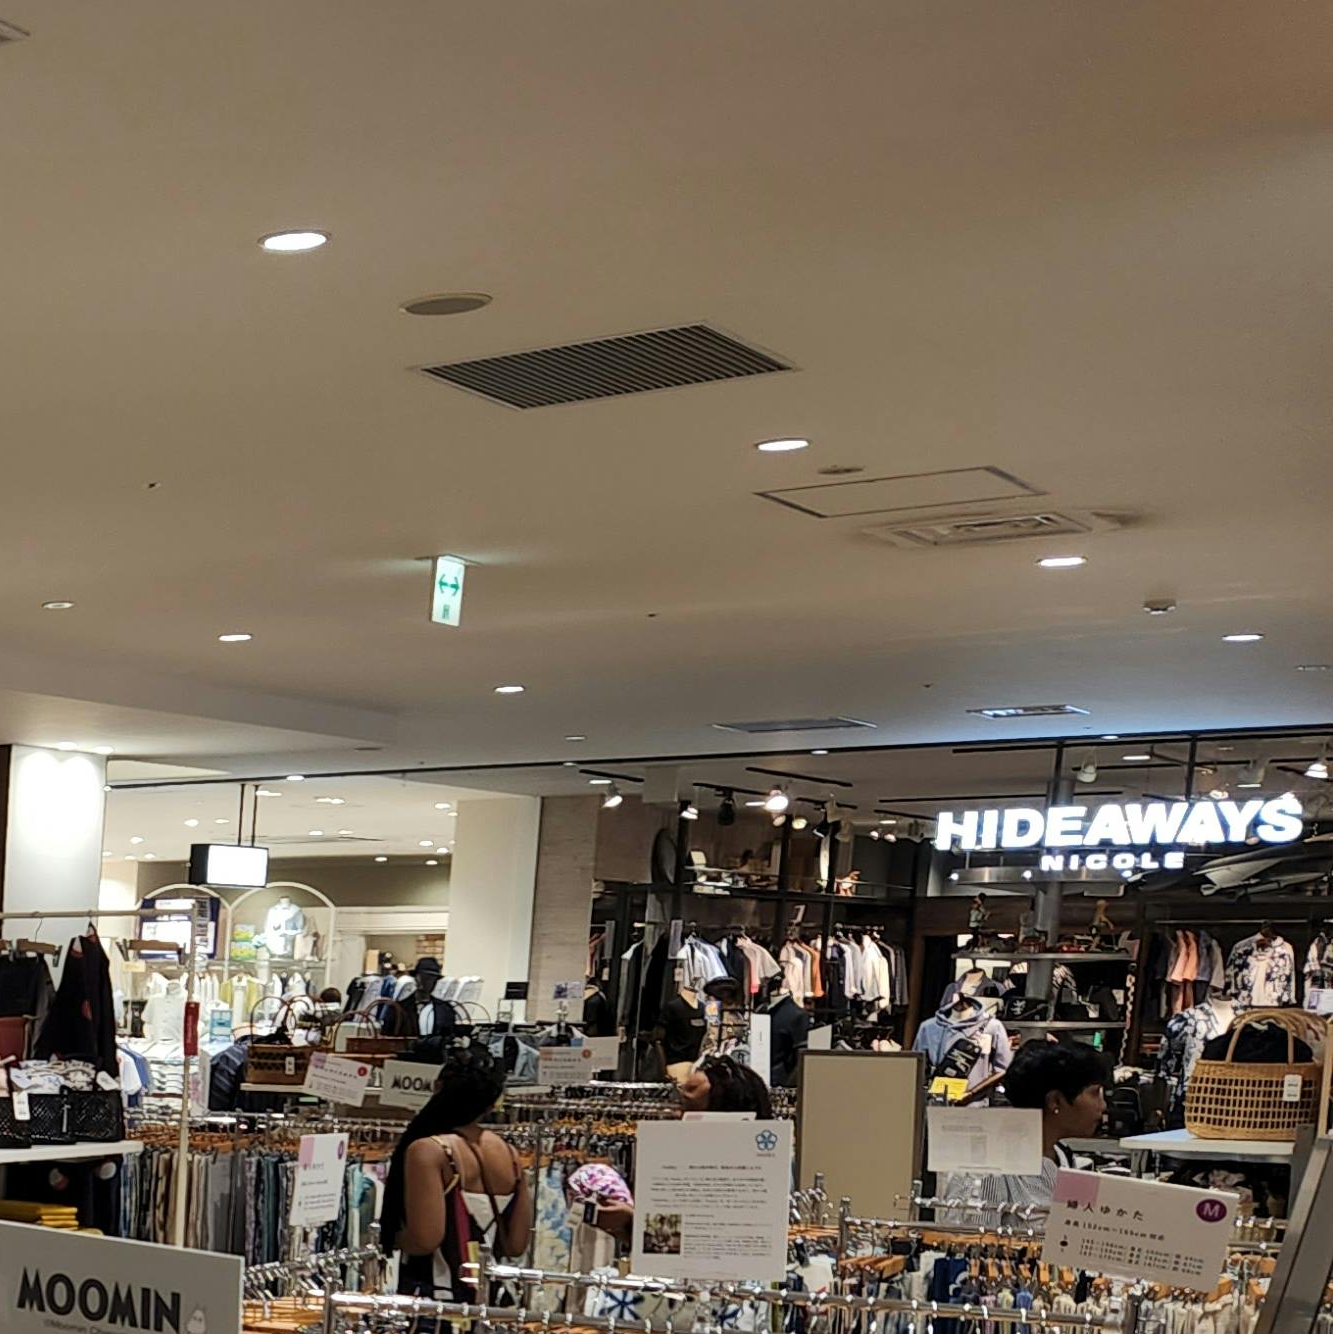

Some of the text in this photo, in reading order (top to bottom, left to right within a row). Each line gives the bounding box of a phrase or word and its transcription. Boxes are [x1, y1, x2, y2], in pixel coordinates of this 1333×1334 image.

[934, 799, 1303, 852] HIDEAWAYS
[1040, 852, 1185, 872] NICOLE
[391, 1073, 432, 1092] MOOM
[1202, 1202, 1220, 1218] M
